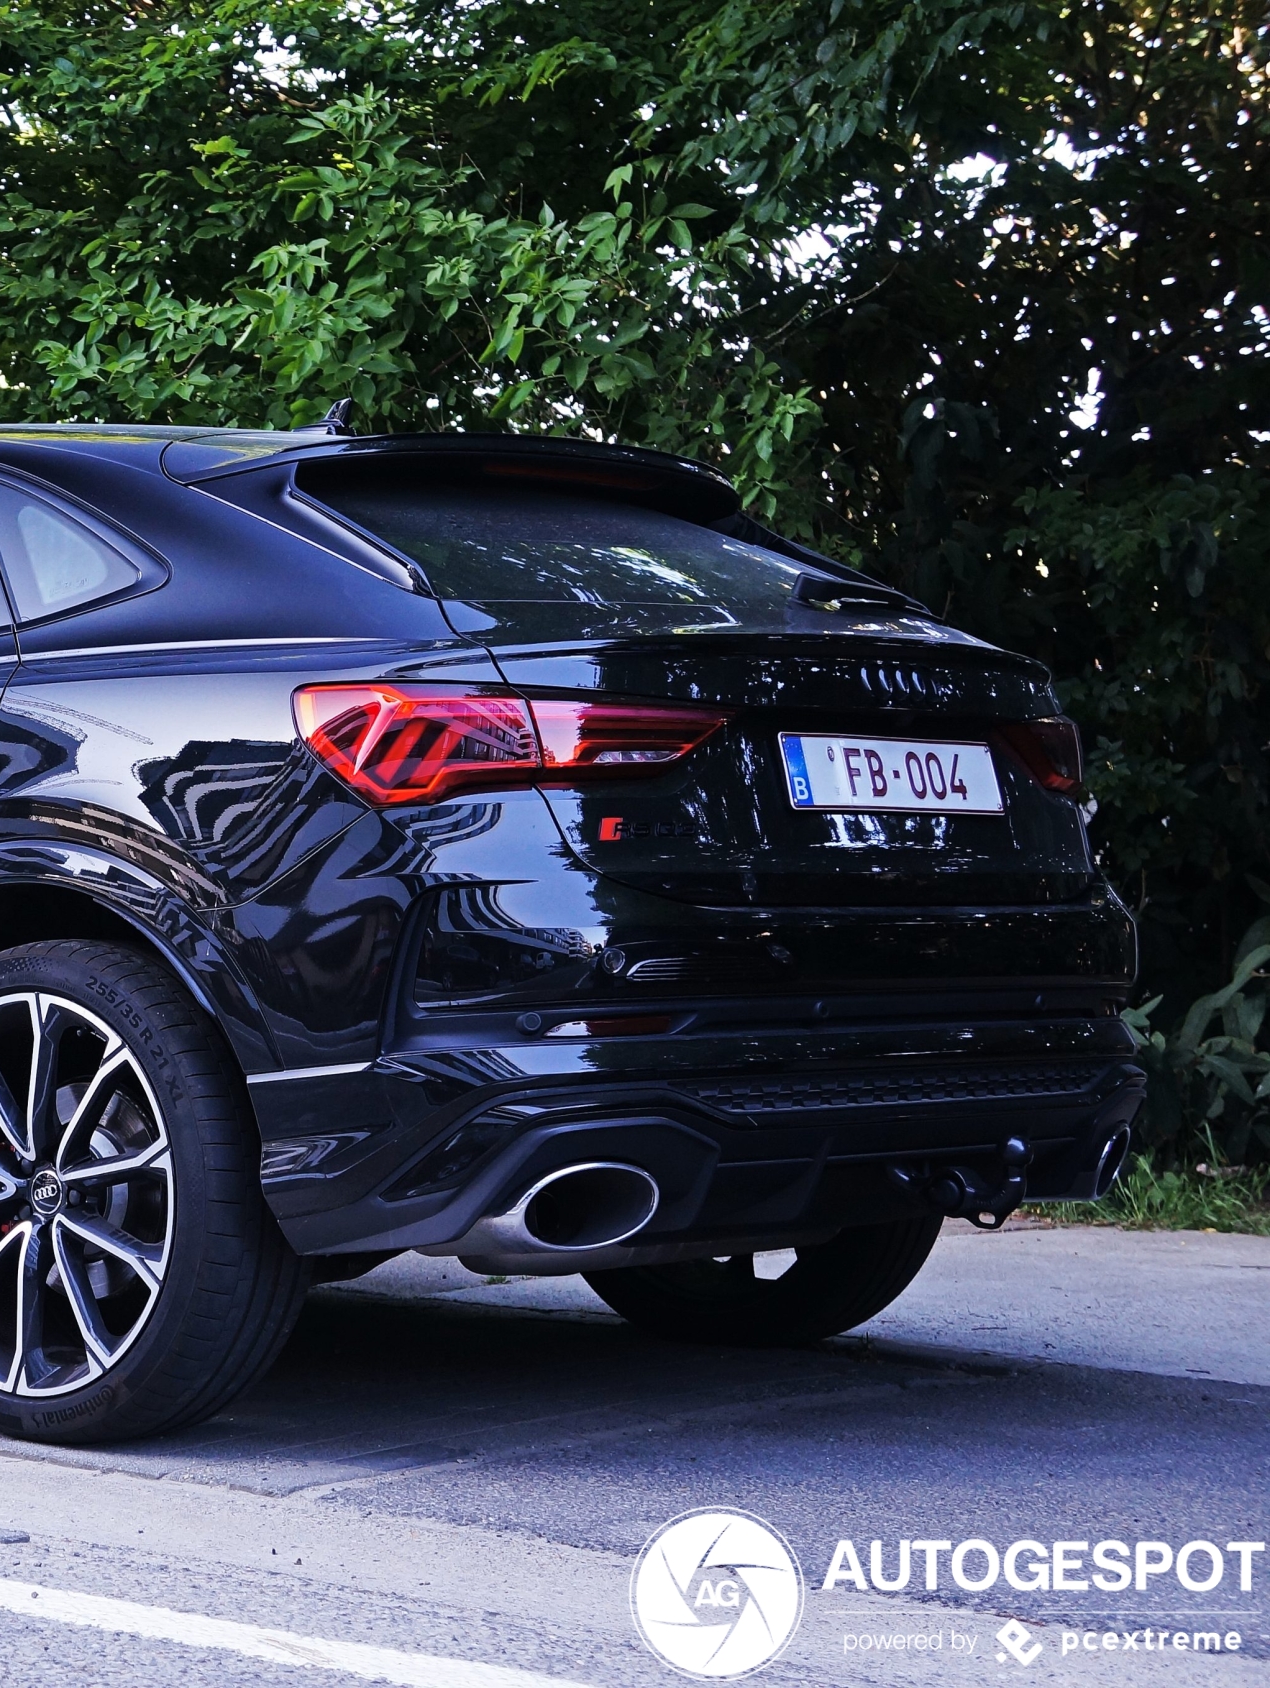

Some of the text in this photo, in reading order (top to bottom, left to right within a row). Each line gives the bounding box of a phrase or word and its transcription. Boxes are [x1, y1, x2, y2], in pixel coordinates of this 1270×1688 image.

[793, 776, 809, 800] B
[841, 747, 968, 800] FB-004
[85, 975, 183, 1109] 255/35 R 21 XL
[42, 1384, 116, 1428] Continental
